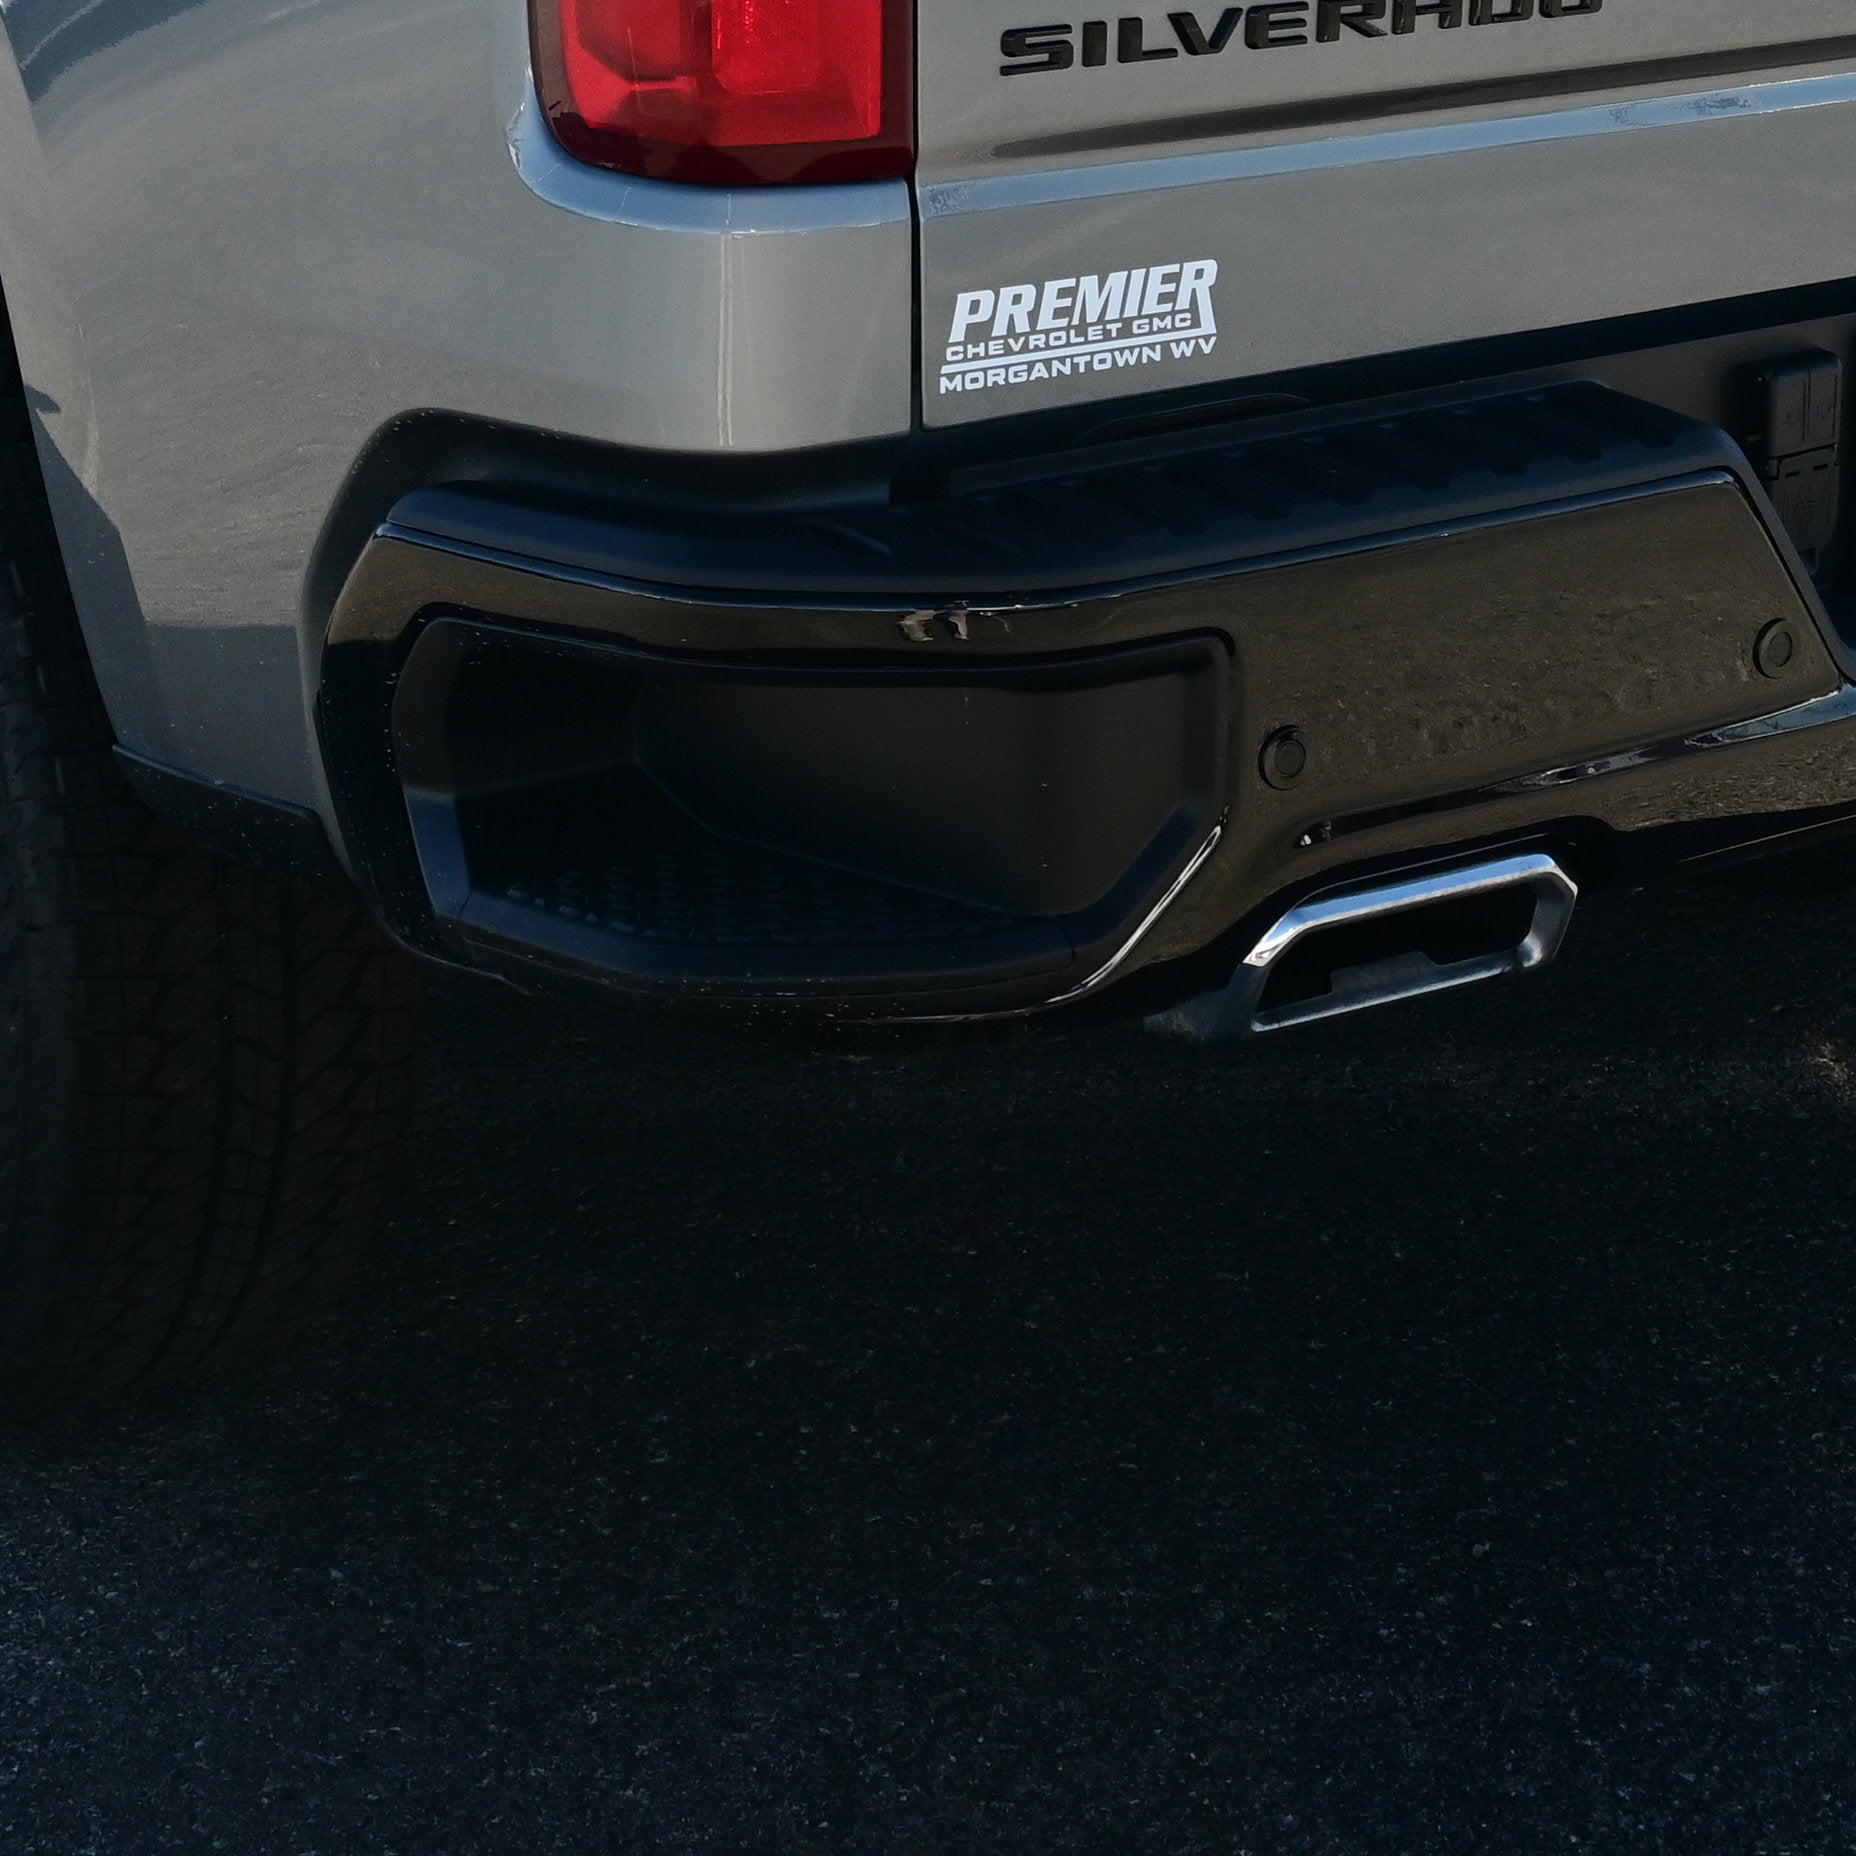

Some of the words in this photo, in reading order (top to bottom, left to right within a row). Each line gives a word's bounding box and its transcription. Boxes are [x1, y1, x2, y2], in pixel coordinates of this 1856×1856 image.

[948, 259, 1218, 344] PREMIER
[939, 344, 1162, 394] MORGANTOWN
[1170, 336, 1217, 359] WV
[945, 322, 1123, 362] CHEVROLET
[1132, 313, 1192, 334] GMC
